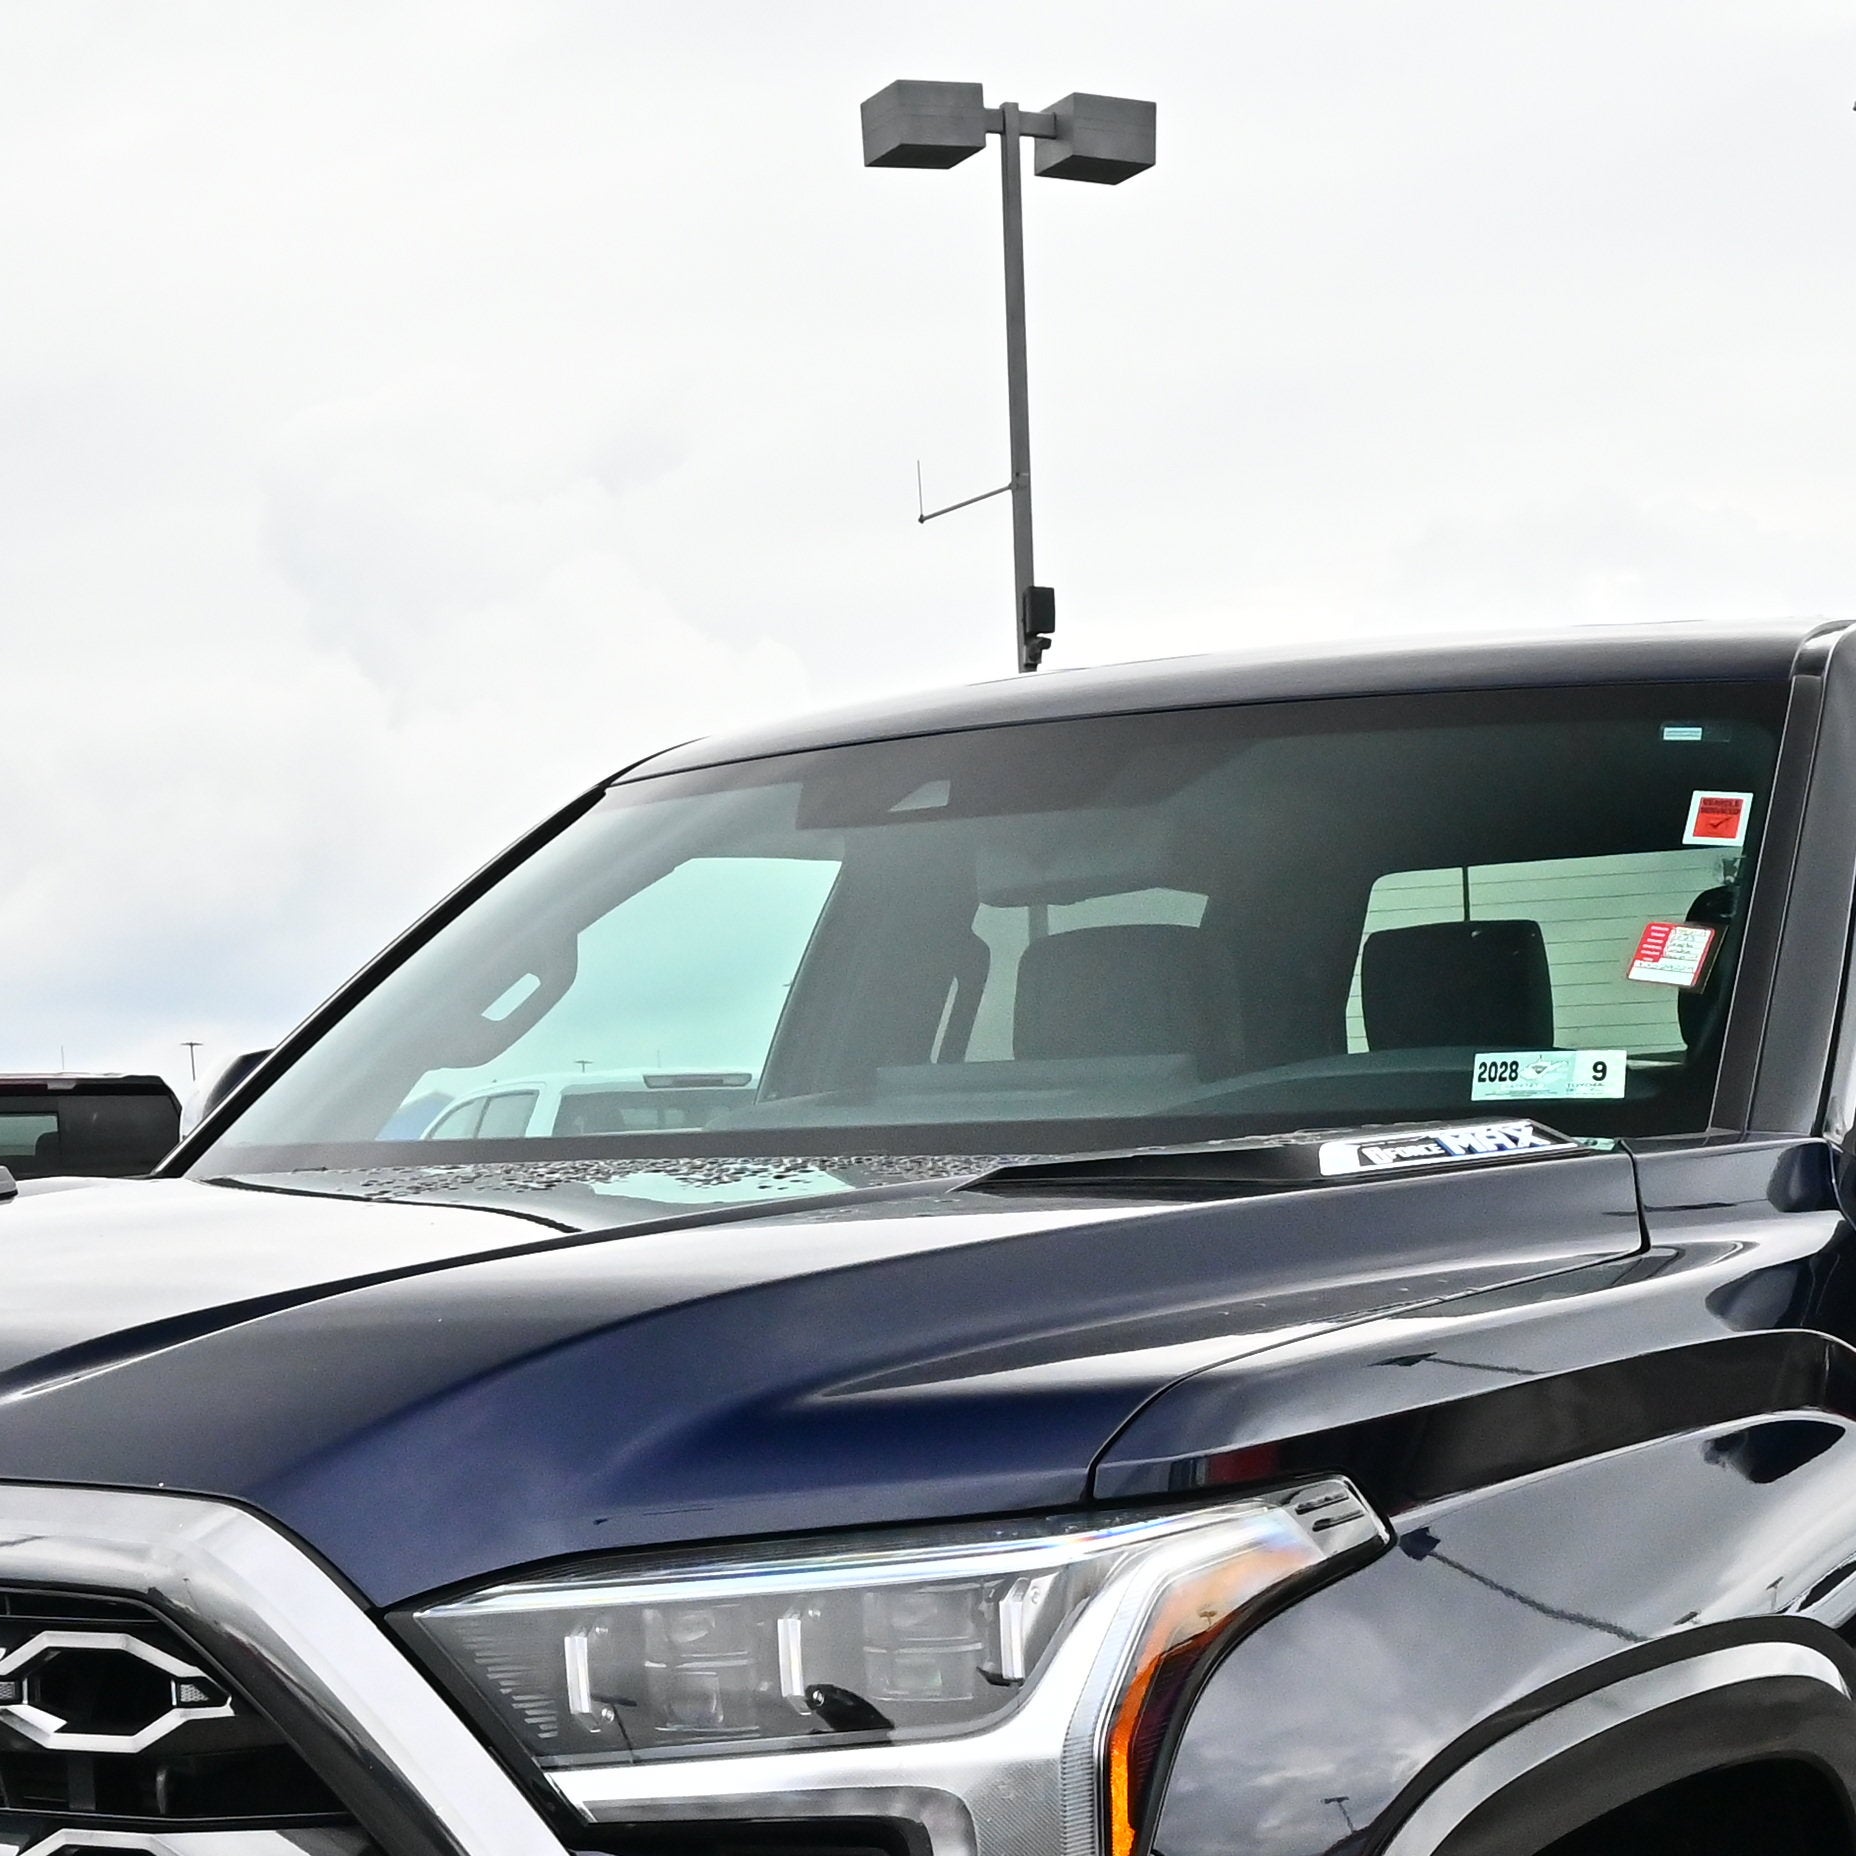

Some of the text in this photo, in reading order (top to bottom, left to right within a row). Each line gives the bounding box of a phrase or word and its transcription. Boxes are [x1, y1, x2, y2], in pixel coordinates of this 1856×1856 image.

[1477, 1060, 1607, 1083] 2028 9
[1435, 1121, 1551, 1157] MAX
